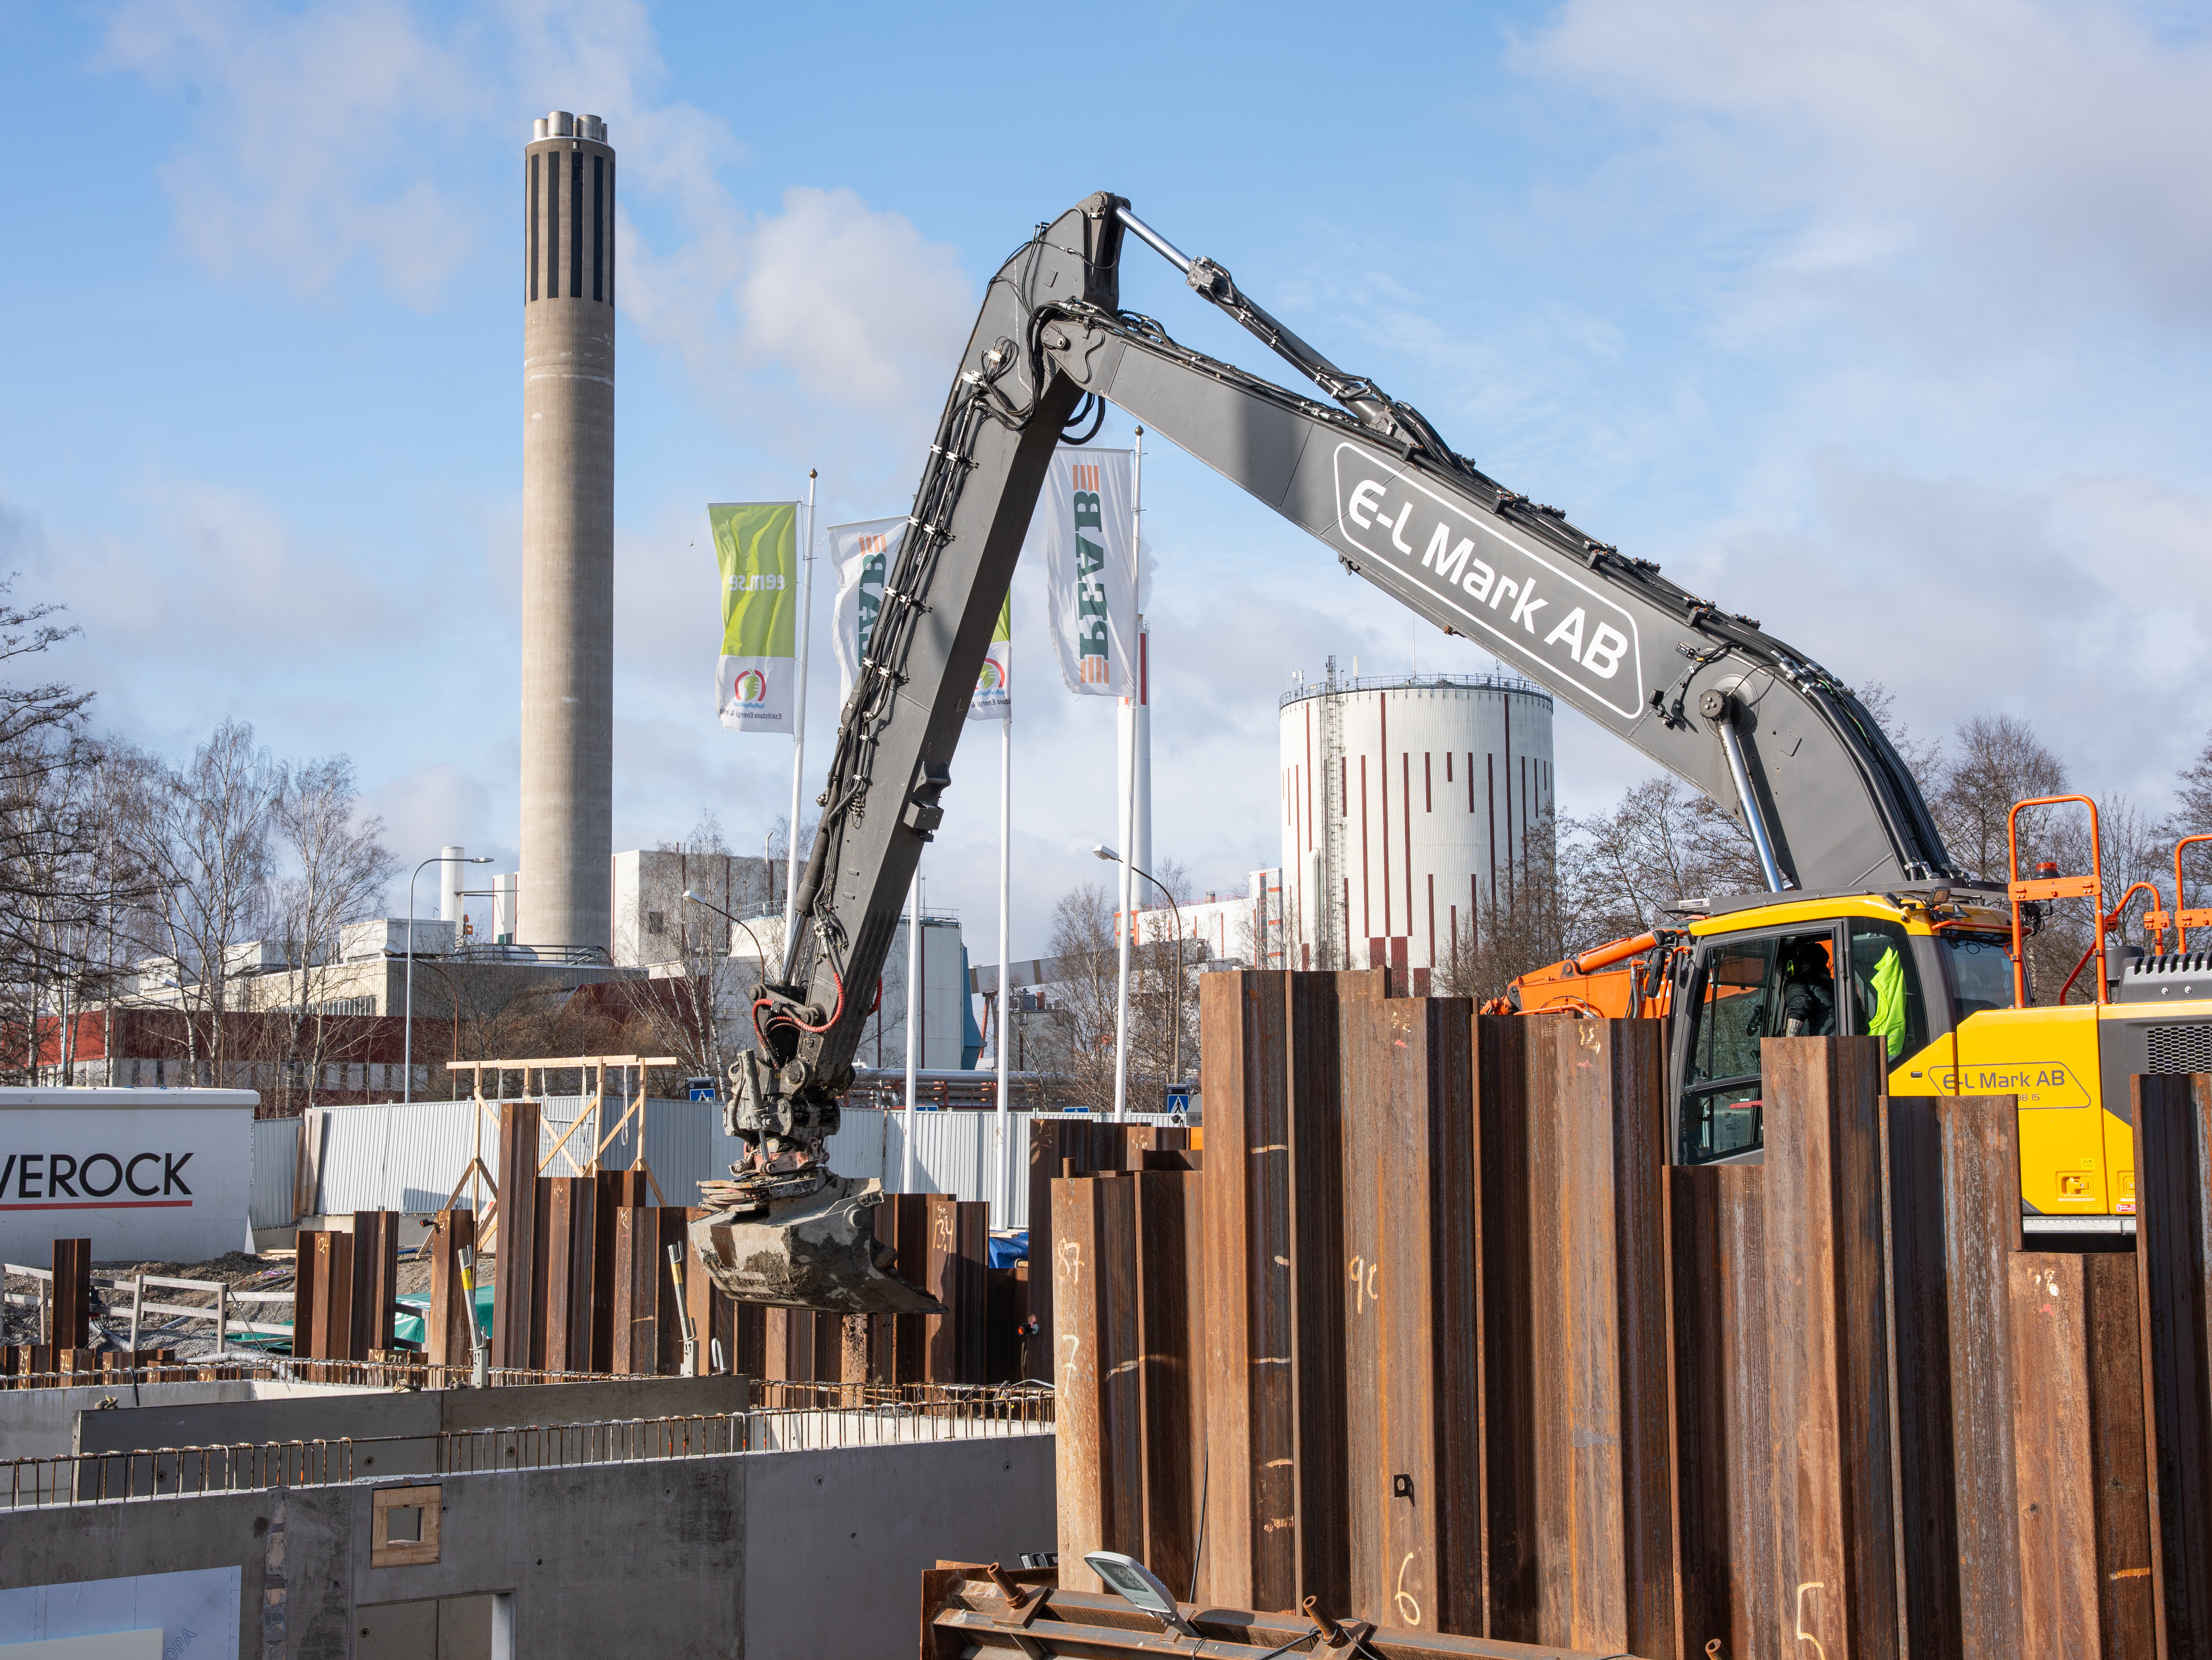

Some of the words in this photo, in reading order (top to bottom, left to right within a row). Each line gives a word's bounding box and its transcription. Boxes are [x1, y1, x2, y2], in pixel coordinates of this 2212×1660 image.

[1349, 480, 1413, 555] E-L
[1422, 522, 1548, 634] Mark
[1543, 607, 1628, 679] AB
[1943, 1073, 1975, 1089] E-L
[1980, 1071, 2031, 1088] Mark
[2036, 1070, 2065, 1087] AB
[0, 1152, 194, 1199] EROCK
[1063, 1335, 1080, 1396] 7
[1395, 1552, 1421, 1625] 6
[162, 1629, 197, 1660] OPA
